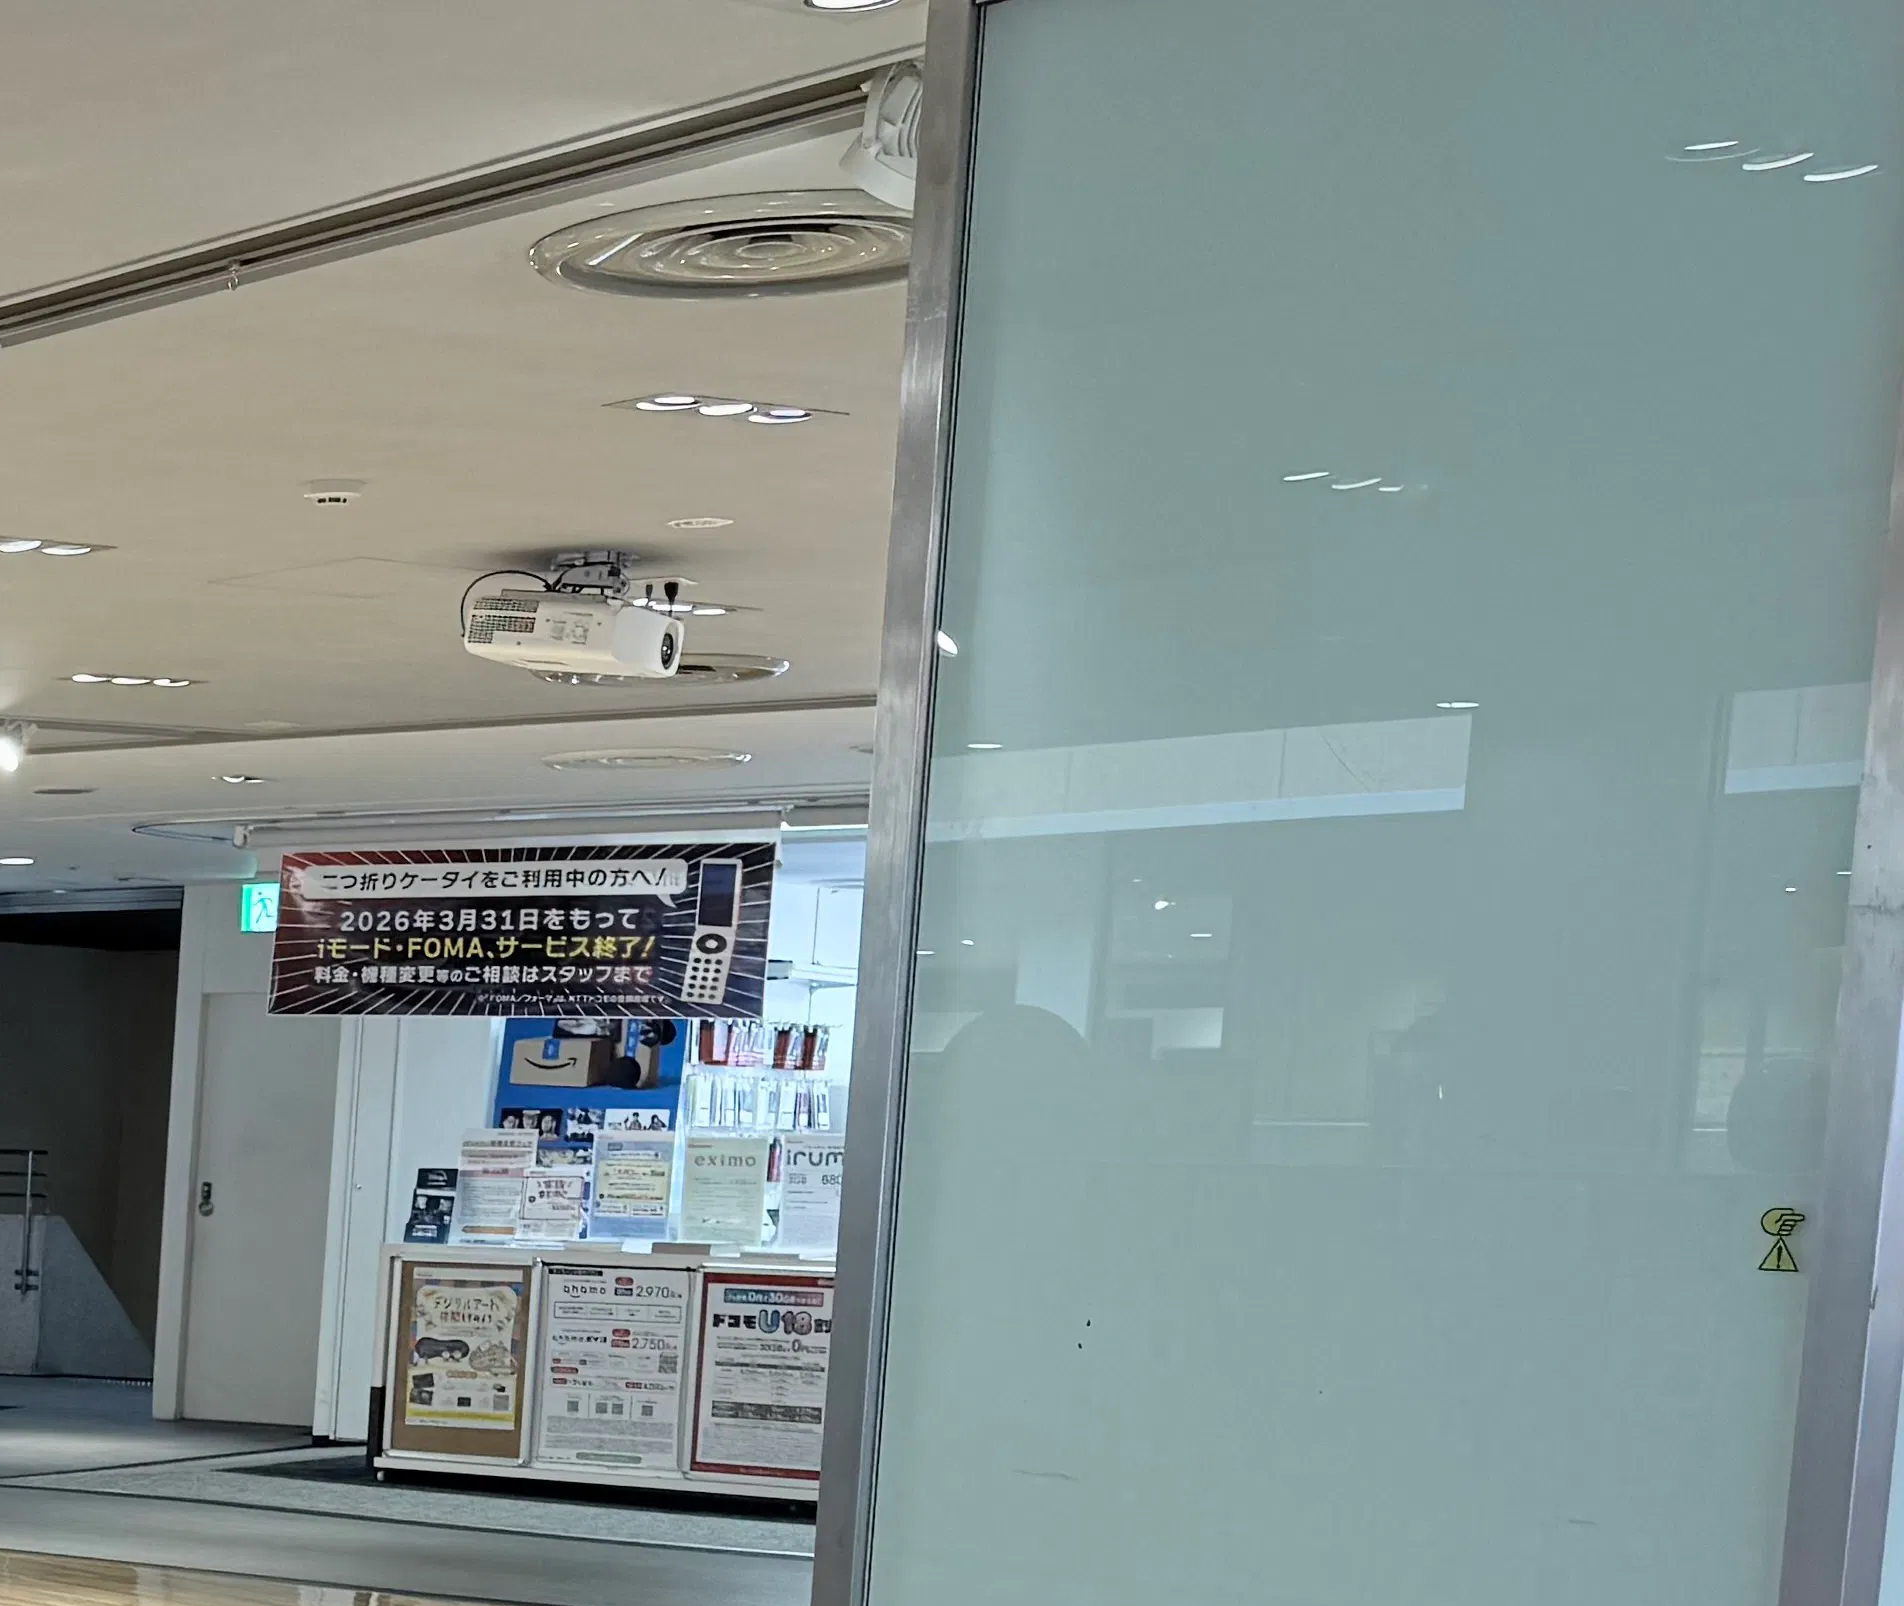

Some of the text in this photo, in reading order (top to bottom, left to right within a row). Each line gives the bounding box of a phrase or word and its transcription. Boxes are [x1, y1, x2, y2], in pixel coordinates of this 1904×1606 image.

[340, 908, 640, 932] 2026年3月31日をもって
[317, 936, 656, 960] iモード・FOMA、サービス終了!
[694, 1153, 757, 1168] eximo
[787, 1149, 844, 1167] irum
